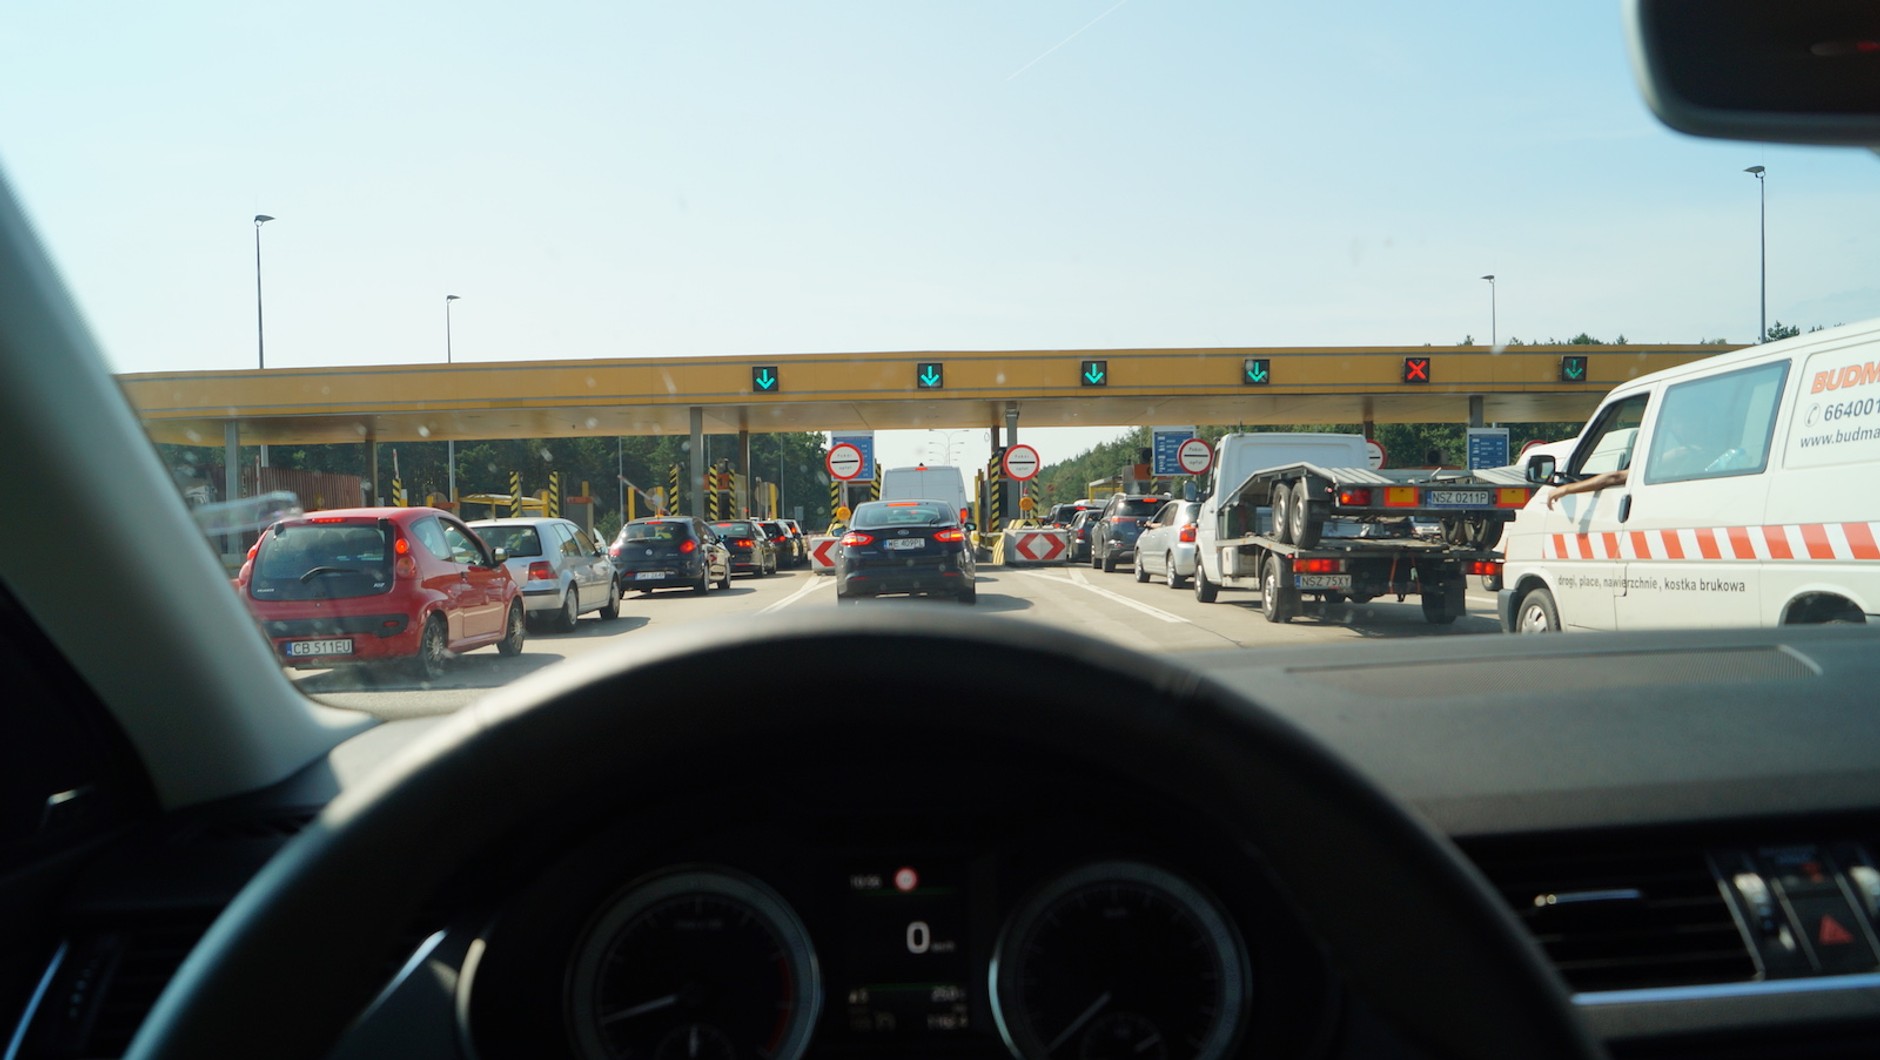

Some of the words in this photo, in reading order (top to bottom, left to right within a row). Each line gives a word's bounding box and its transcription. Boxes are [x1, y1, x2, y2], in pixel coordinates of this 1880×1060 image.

[1810, 361, 1880, 395] BUDM
[1800, 426, 1880, 449] www.budma
[1433, 492, 1453, 503] NSZ
[1455, 492, 1487, 503] 0211P
[1302, 576, 1322, 586] NSZ
[1325, 576, 1350, 586] 75XY
[1664, 577, 1697, 591] kostka
[1699, 578, 1745, 592] brukowa
[293, 642, 310, 654] CB
[314, 641, 350, 653] 511EU
[906, 919, 930, 954] 0
